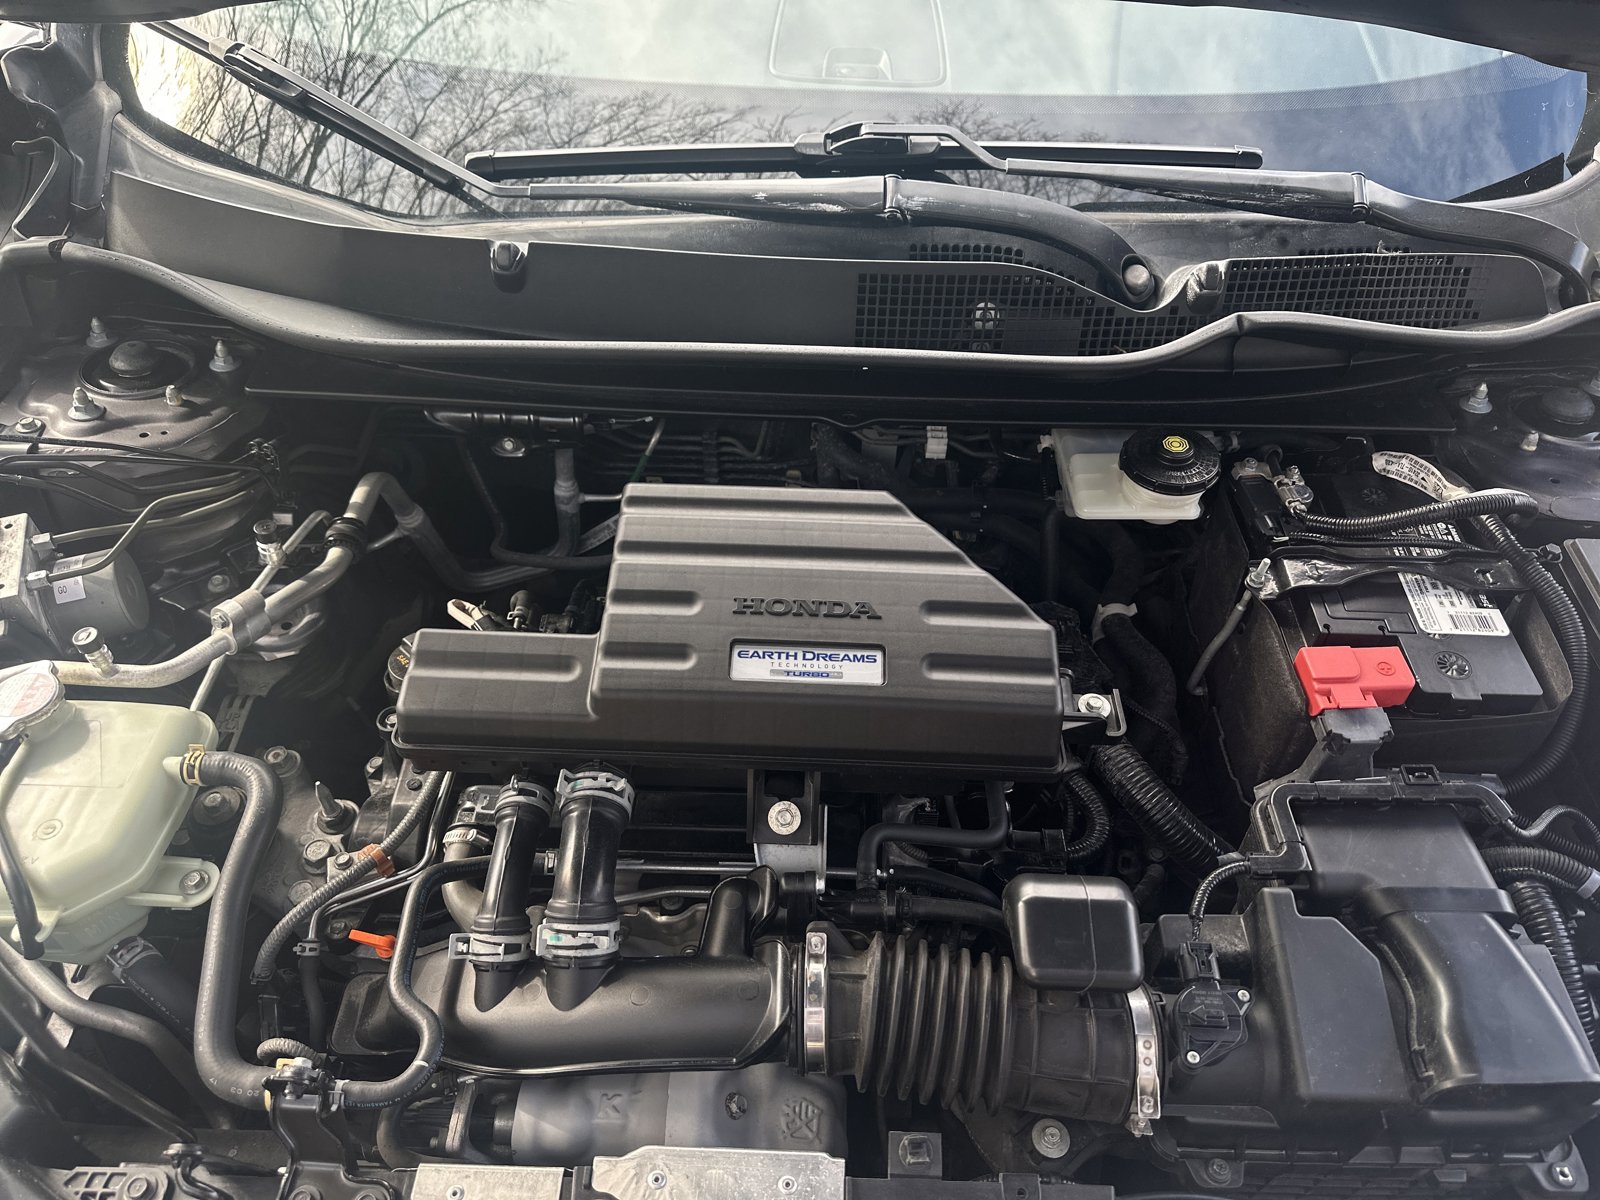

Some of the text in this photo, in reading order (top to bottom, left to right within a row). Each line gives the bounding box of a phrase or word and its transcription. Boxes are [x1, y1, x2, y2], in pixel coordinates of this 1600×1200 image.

[732, 597, 882, 620] HONDA
[737, 650, 877, 664] EARTH DREAMS
[770, 662, 844, 670] TECHNOLOGY
[783, 670, 830, 678] TURBO
